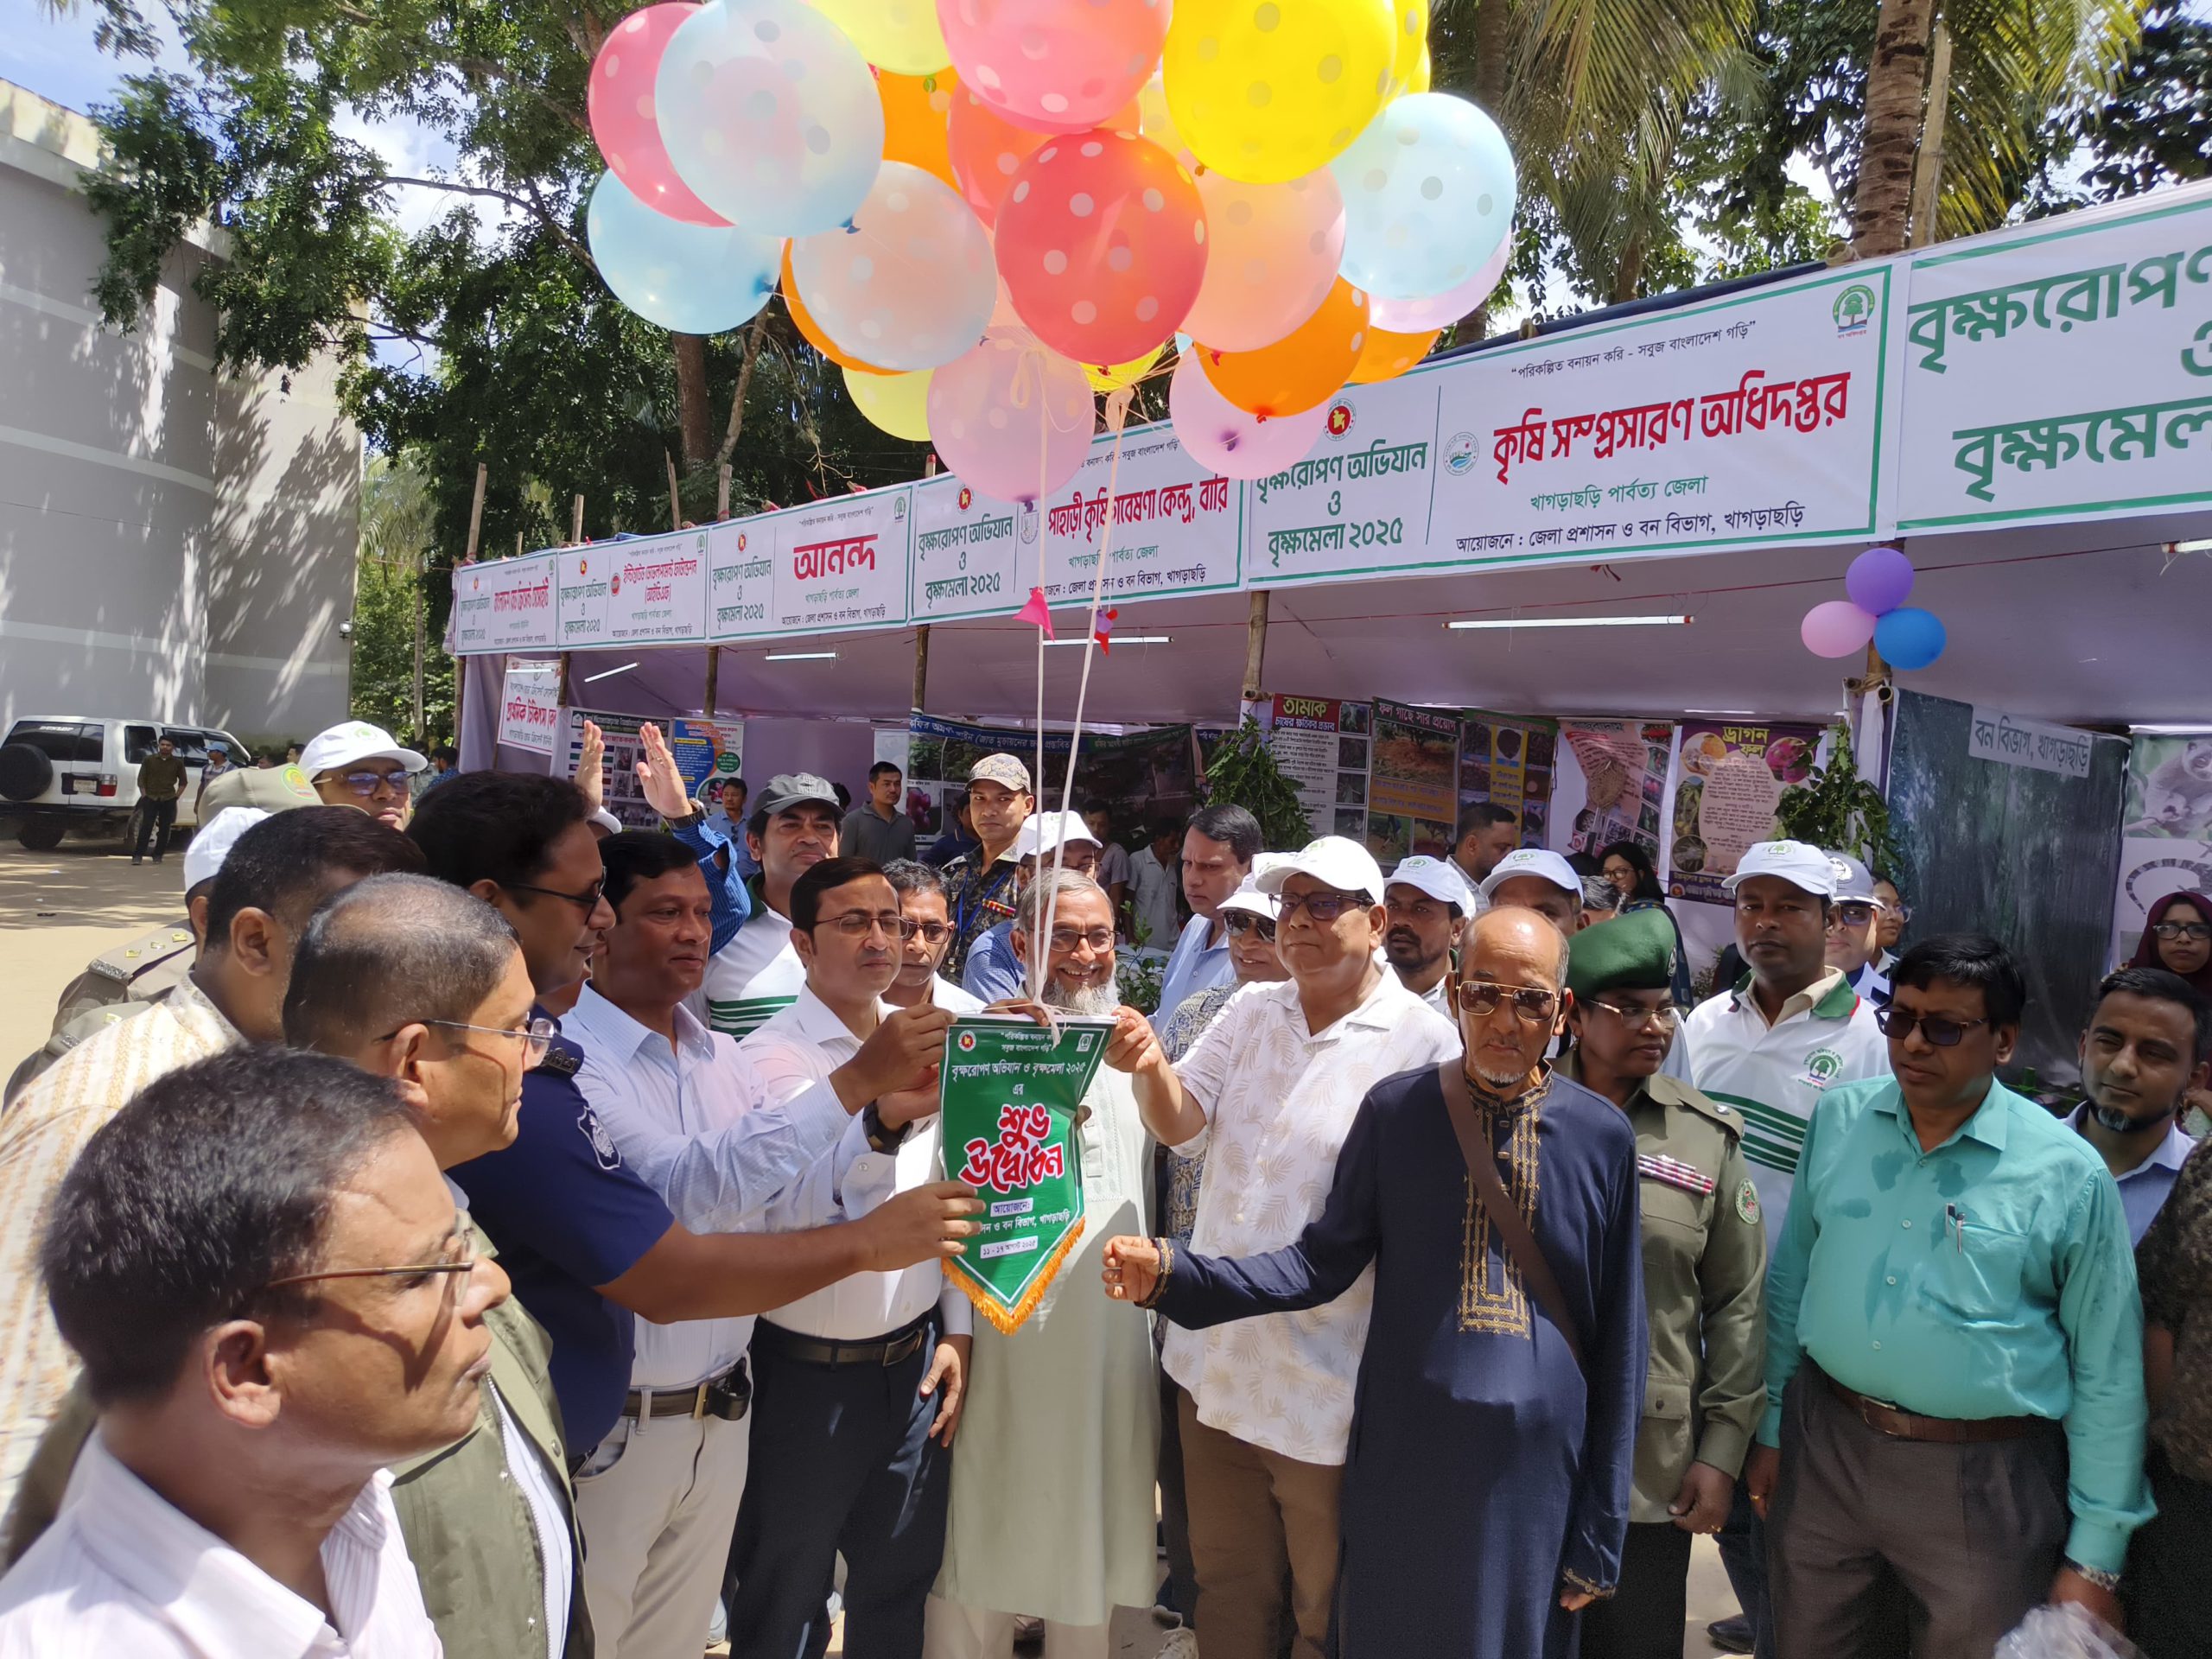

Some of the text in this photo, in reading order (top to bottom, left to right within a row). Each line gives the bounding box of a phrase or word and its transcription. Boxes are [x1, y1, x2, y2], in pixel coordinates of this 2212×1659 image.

[1567, 353, 1599, 370] বনায়ন
[1605, 346, 1624, 363] করি
[1638, 340, 1665, 359] সবুজ
[1669, 331, 1722, 352] বাংলাদেশ
[1494, 408, 1548, 485] কৃষি
[1551, 397, 1694, 459] সম্প্রসারণ
[1700, 370, 1851, 436] অধিদপ্তর
[1347, 439, 1428, 479] অভিযান
[1952, 397, 2212, 502] বৃক্ষমেল
[1327, 490, 1341, 516] ও
[1530, 475, 1709, 512] খাগড়াছড়ি পার্বত্য জেলা
[1048, 491, 1082, 540] পাহাড়ী
[1529, 528, 1562, 547] জেলা
[1566, 522, 1617, 544] প্রশাসন
[1622, 523, 1633, 537] ও
[1639, 518, 1662, 534] বন
[1724, 501, 1806, 531] খাগড়াছড়ি
[918, 513, 1013, 562] বৃক্ষরোপণ অভিযান
[1136, 544, 1159, 560] জেলা
[1268, 518, 1403, 568] বৃক্ষমেলা ২০২৫
[744, 556, 772, 579] অভিযান
[793, 533, 878, 580] আনন্দ
[958, 551, 967, 570] ও
[1166, 563, 1206, 584] খাগড়াছড়ি
[925, 572, 1001, 609] বৃক্ষমেলা ২০২৫
[1283, 696, 1329, 717] তামাক
[1396, 707, 1414, 724] গাছে
[1416, 711, 1430, 726] সার
[1722, 726, 1770, 745] ড্রাগন
[1738, 743, 1765, 759] ফল
[1975, 720, 1995, 749] বন
[2037, 733, 2090, 772] খাগড়াছড়ি
[991, 1059, 1022, 1075] অভিযান
[1024, 1063, 1031, 1073] ও
[1013, 1084, 1024, 1096] এর
[997, 1103, 1052, 1152] শুভ
[957, 1137, 1065, 1194] উদ্বোধন
